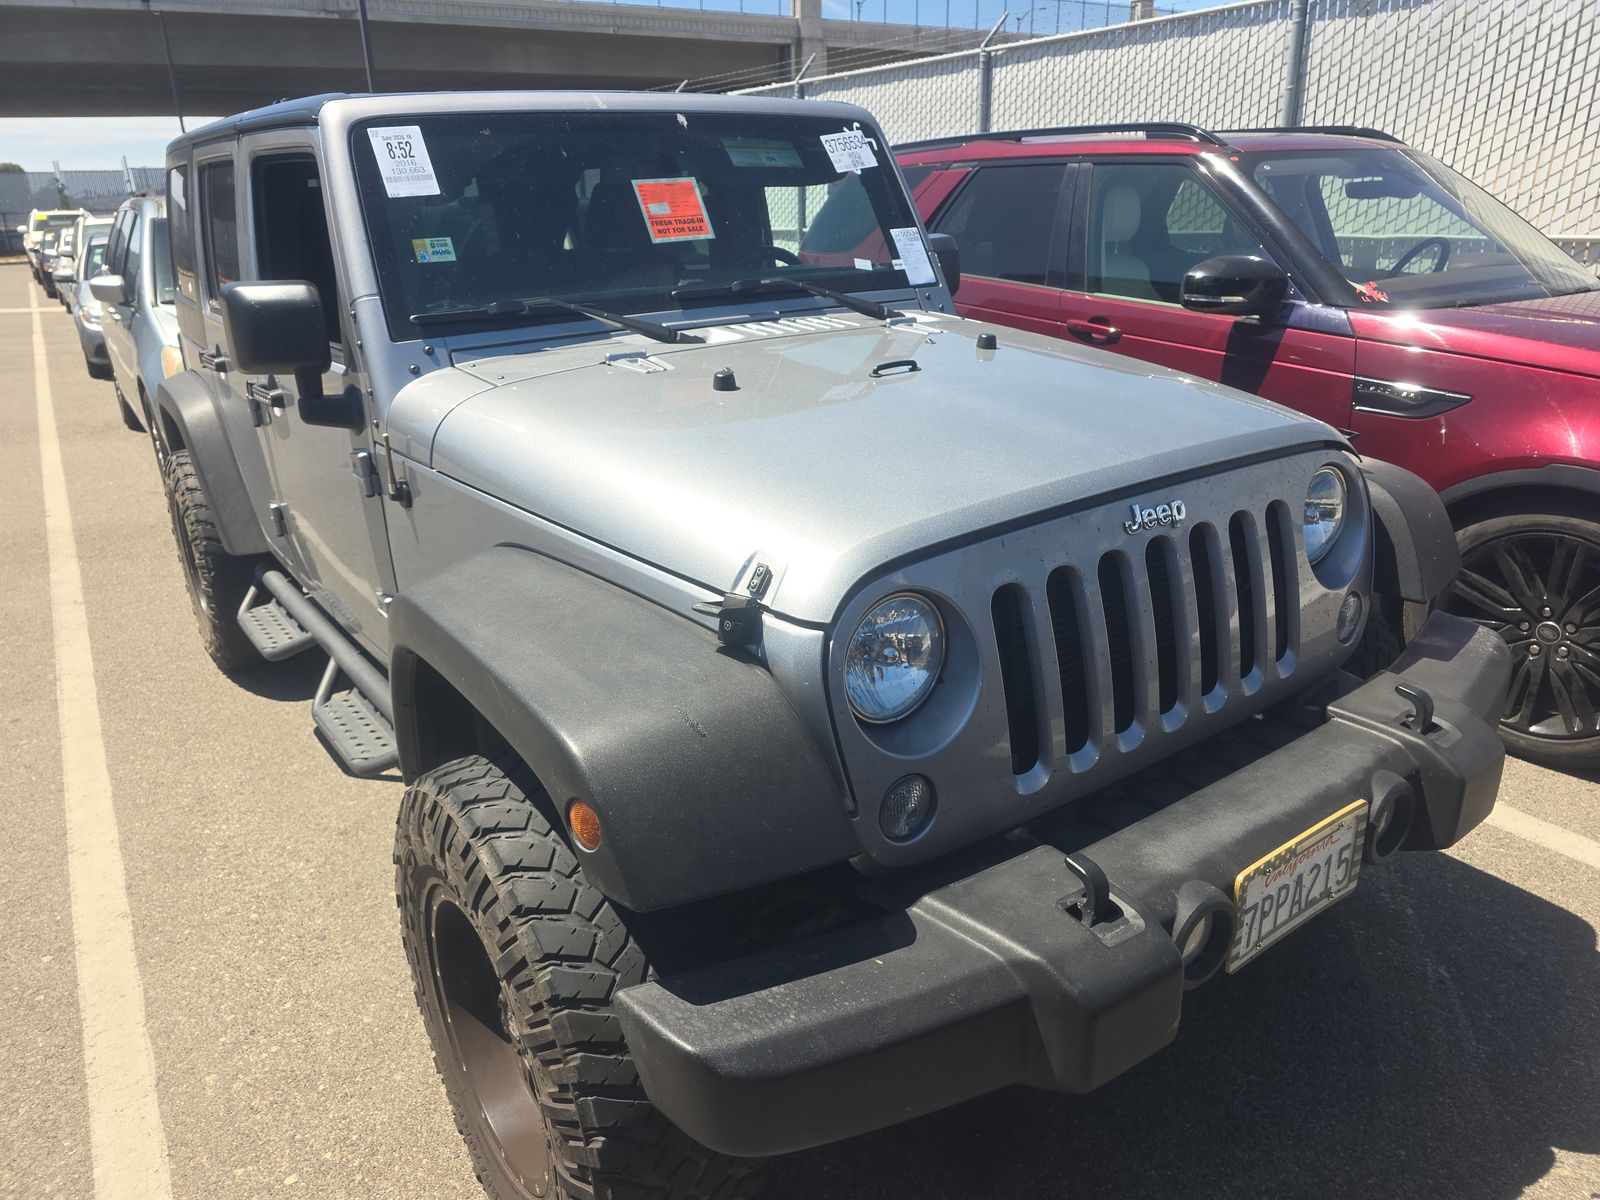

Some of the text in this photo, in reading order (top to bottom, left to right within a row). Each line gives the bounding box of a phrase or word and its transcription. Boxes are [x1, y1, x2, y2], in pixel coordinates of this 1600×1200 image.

[386, 141, 415, 159] 8:52
[825, 135, 869, 153] 3756534
[391, 166, 426, 175] 130,663
[394, 159, 417, 167] 2016
[674, 217, 704, 225] TRADE-IN
[1124, 500, 1186, 534] Jeep
[1265, 835, 1340, 888] California
[1244, 843, 1352, 948] 7PPA215
